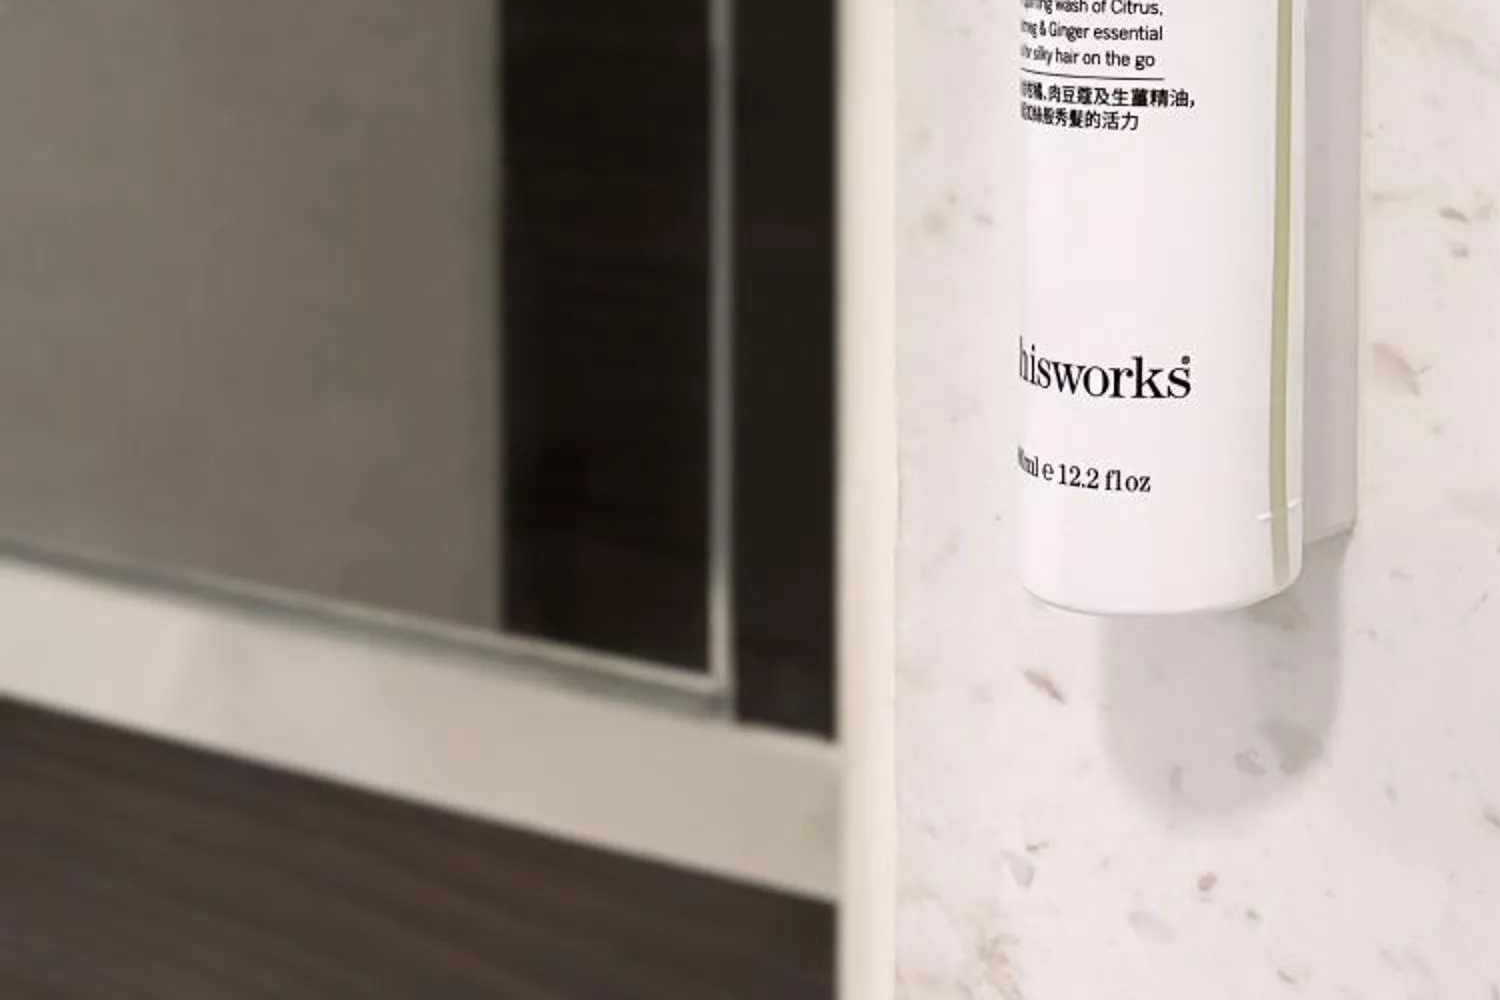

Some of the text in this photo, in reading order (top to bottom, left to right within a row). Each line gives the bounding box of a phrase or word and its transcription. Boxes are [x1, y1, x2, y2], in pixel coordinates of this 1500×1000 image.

[1049, 21, 1090, 42] Ginger
[1093, 26, 1163, 41] essential
[1055, 46, 1079, 63] hair
[1082, 53, 1101, 65] on
[1105, 50, 1131, 67] the
[1135, 55, 1155, 71] go
[1019, 335, 1191, 399] hisworks
[1057, 462, 1100, 491] 12.2
